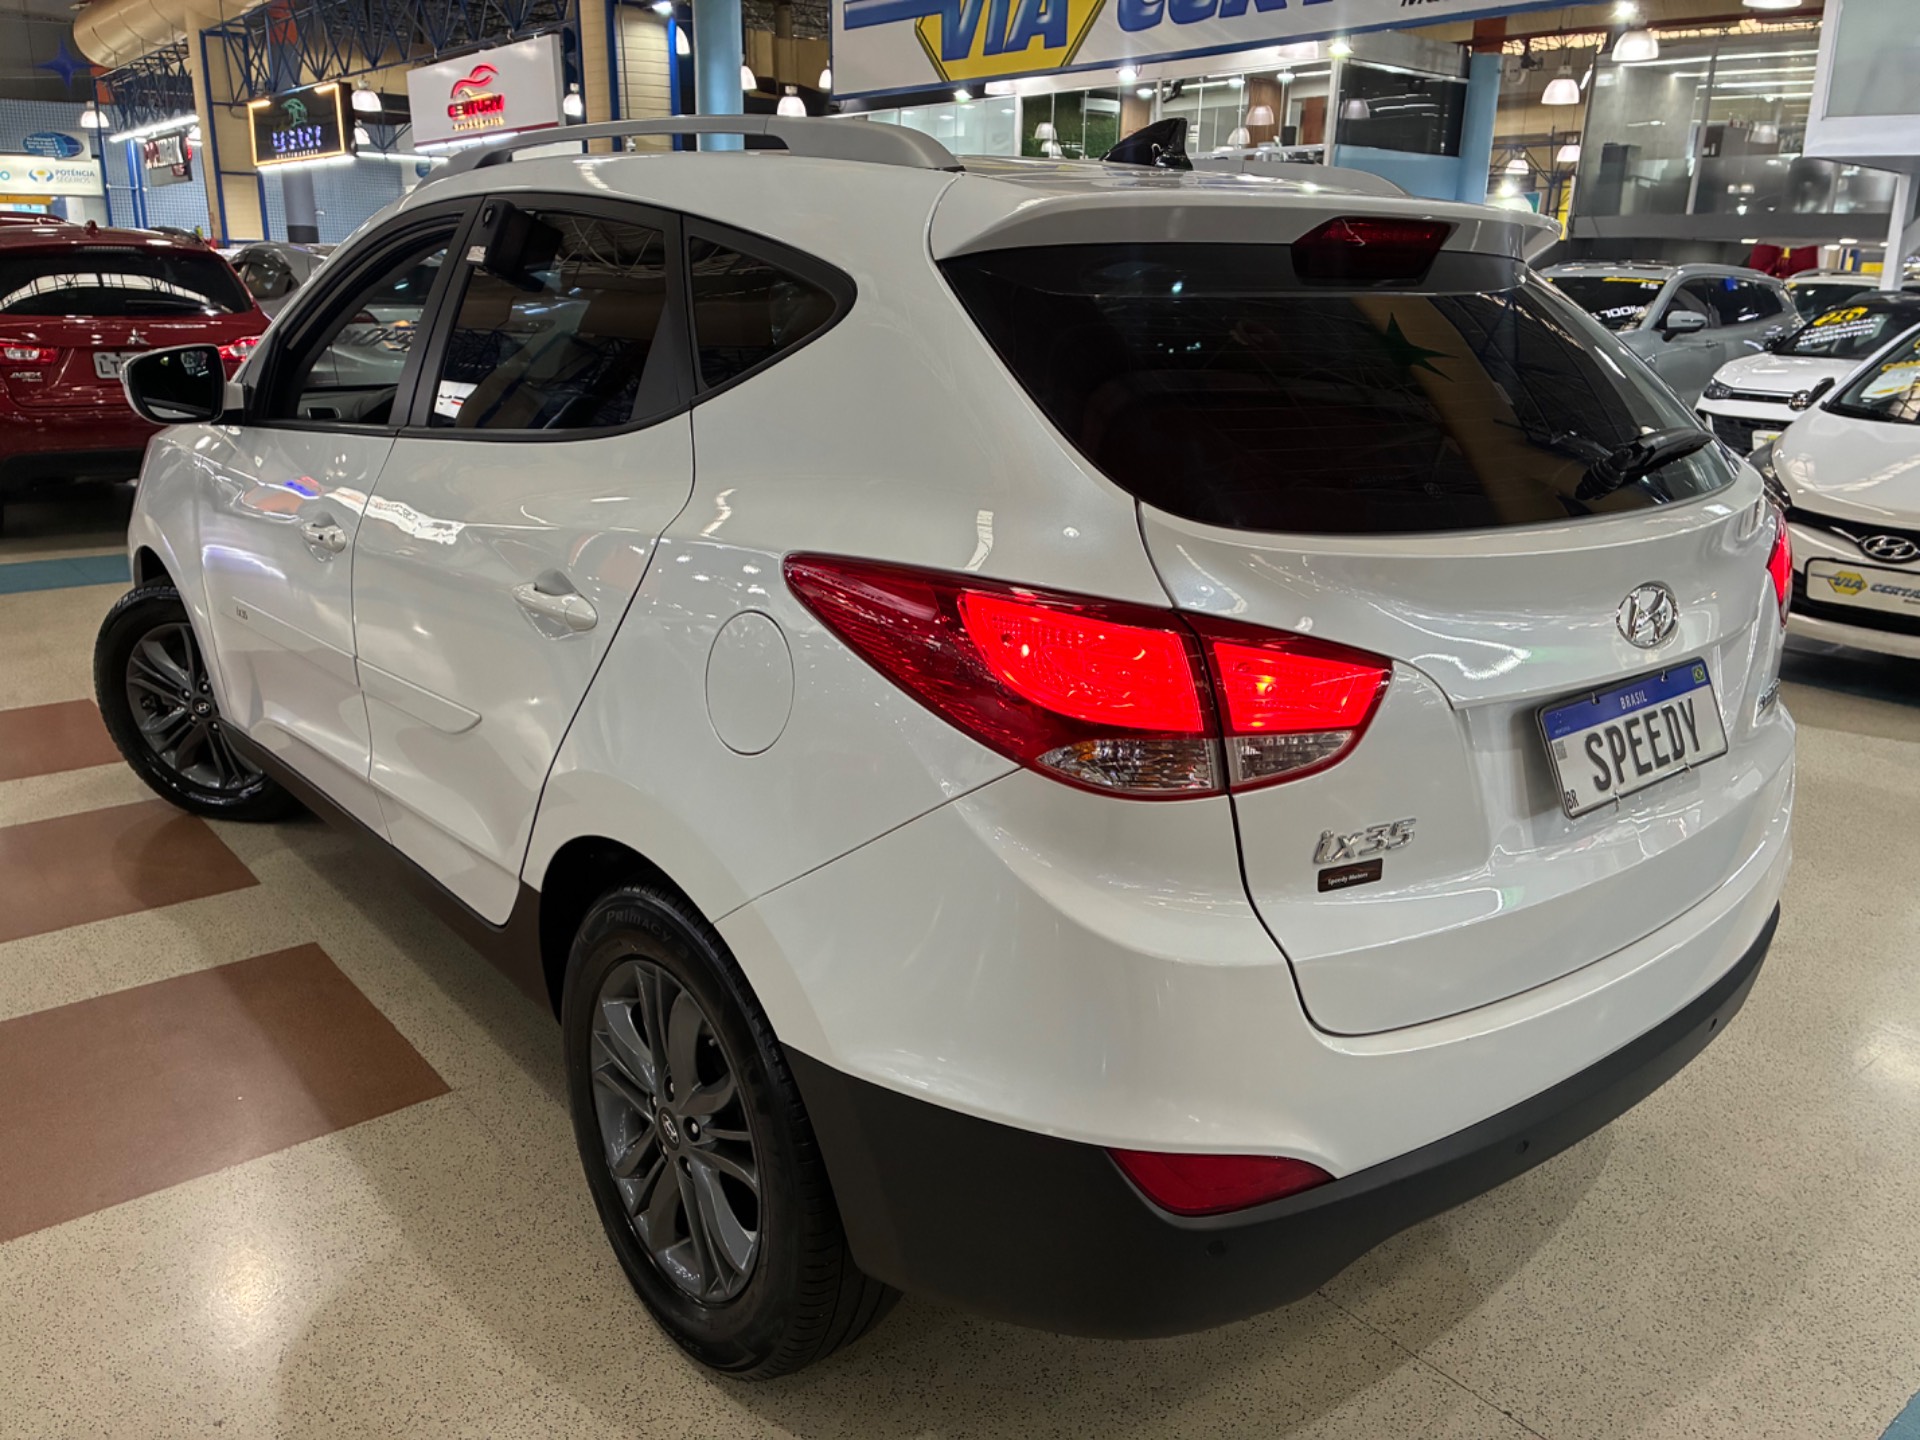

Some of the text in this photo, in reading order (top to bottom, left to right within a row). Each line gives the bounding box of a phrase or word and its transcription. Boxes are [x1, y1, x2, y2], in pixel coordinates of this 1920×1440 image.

[940, 0, 1068, 62] VIA
[447, 94, 505, 119] CENTURY
[1834, 576, 1863, 590] VIA
[1619, 691, 1648, 710] BRASIL
[1584, 696, 1701, 792] SPEEDY
[1565, 789, 1580, 810] BR
[1313, 817, 1417, 864] ix35
[1327, 875, 1348, 886] Speedy
